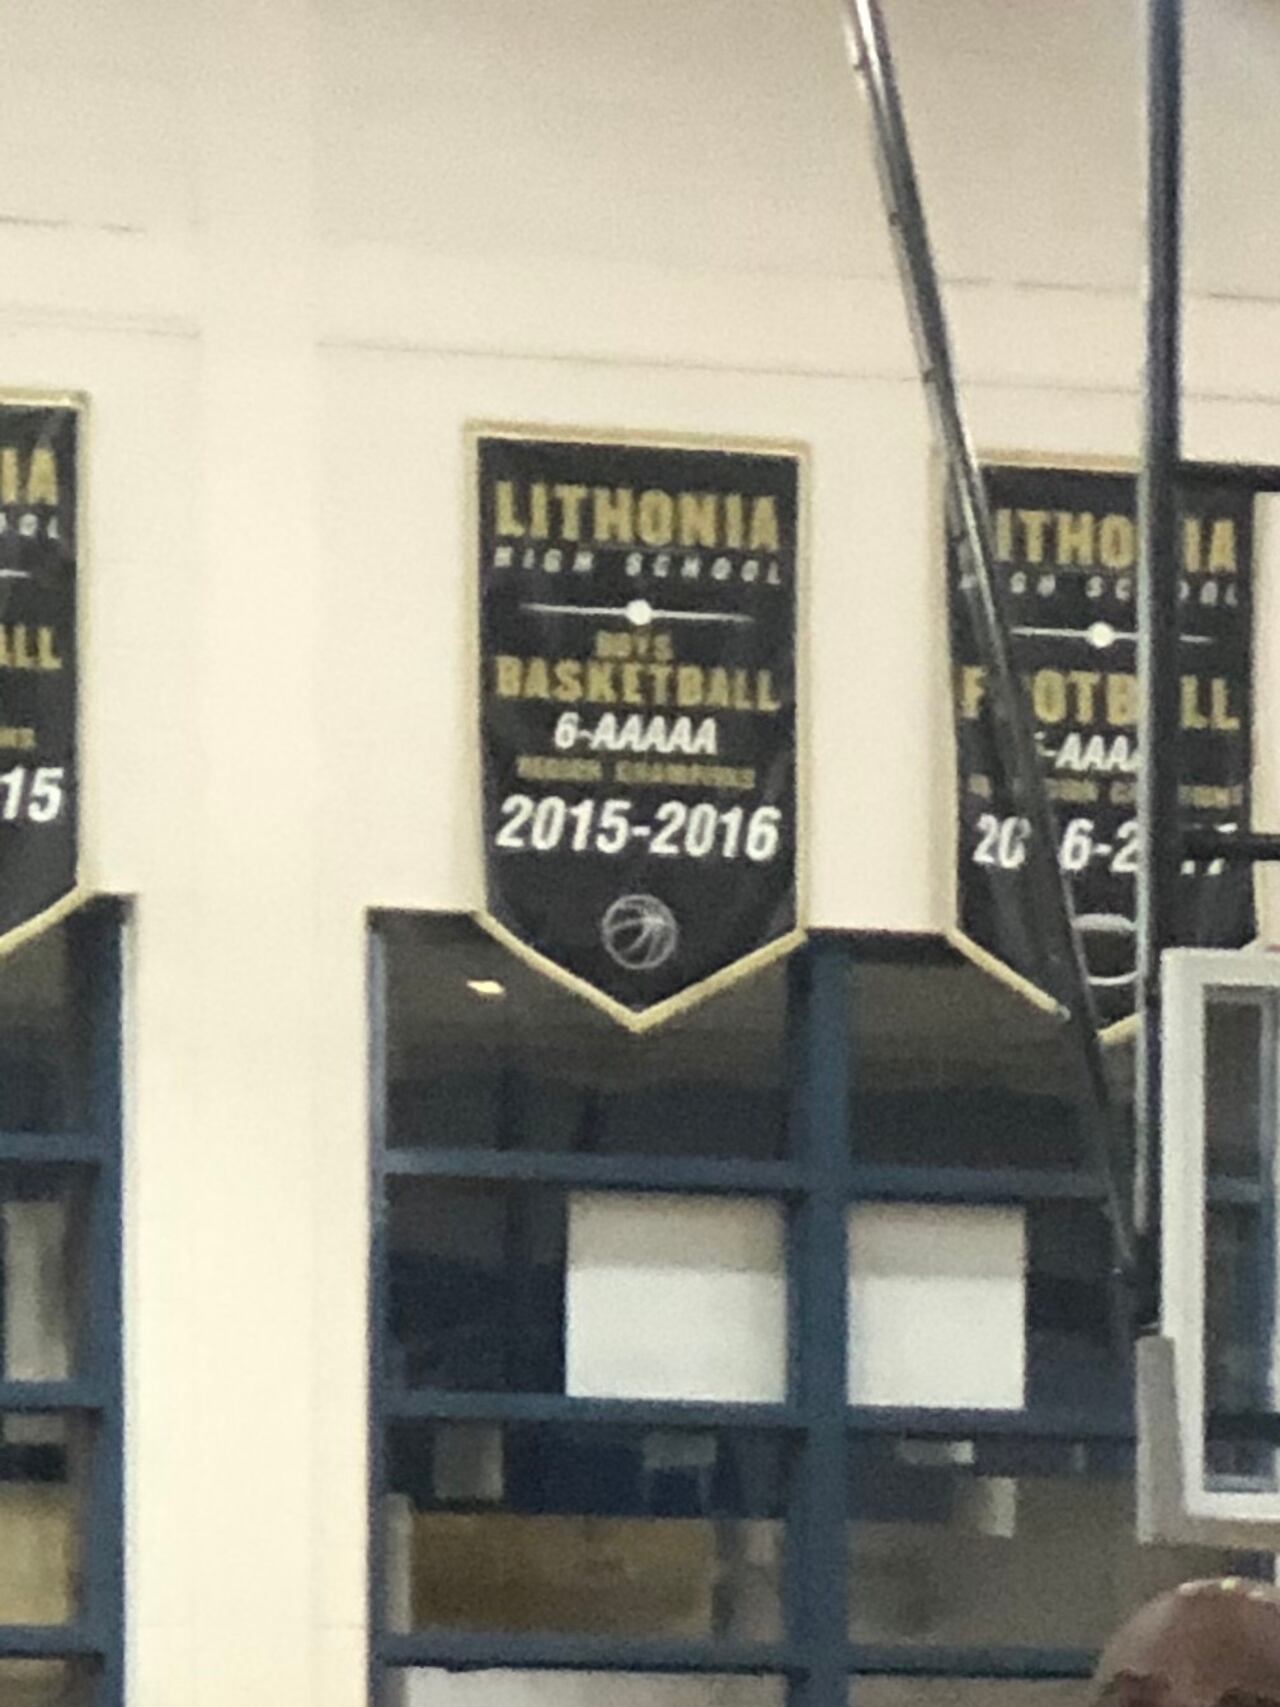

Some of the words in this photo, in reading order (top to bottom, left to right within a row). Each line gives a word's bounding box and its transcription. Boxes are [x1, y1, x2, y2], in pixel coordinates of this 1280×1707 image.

[494, 480, 780, 550] LITHONIA
[993, 507, 1239, 574] ITHOIA
[493, 546, 594, 574] HIGH
[624, 552, 782, 586] SCHOOL
[494, 655, 781, 712] BASKETBALL
[958, 664, 1241, 731] FOTBLL
[554, 711, 718, 756] 6-AAAAA
[494, 794, 783, 862] 2015-2016
